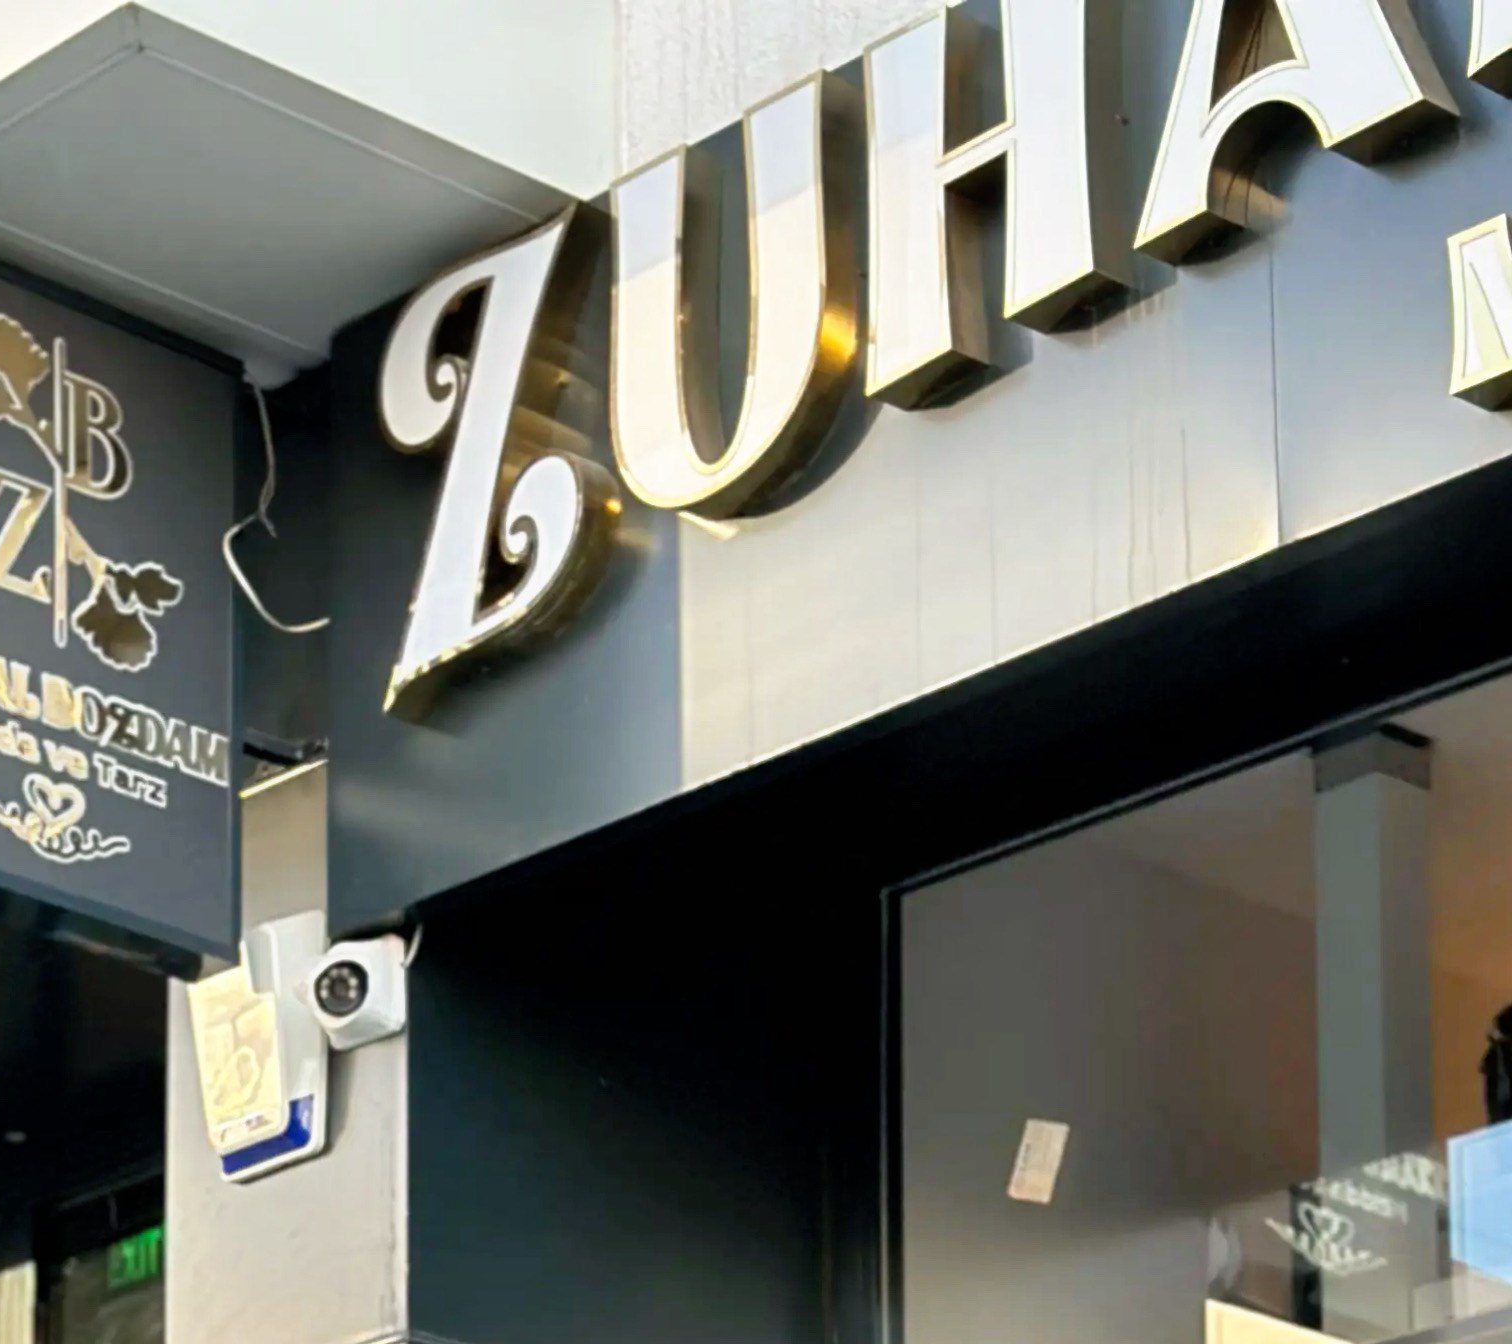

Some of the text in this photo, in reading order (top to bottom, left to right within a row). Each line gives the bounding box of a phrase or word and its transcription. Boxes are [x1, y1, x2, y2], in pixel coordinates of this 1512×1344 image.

[377, 0, 1512, 716] ZUHA
[62, 369, 134, 501] B
[43, 739, 90, 781] ve
[92, 752, 169, 809] Tarz
